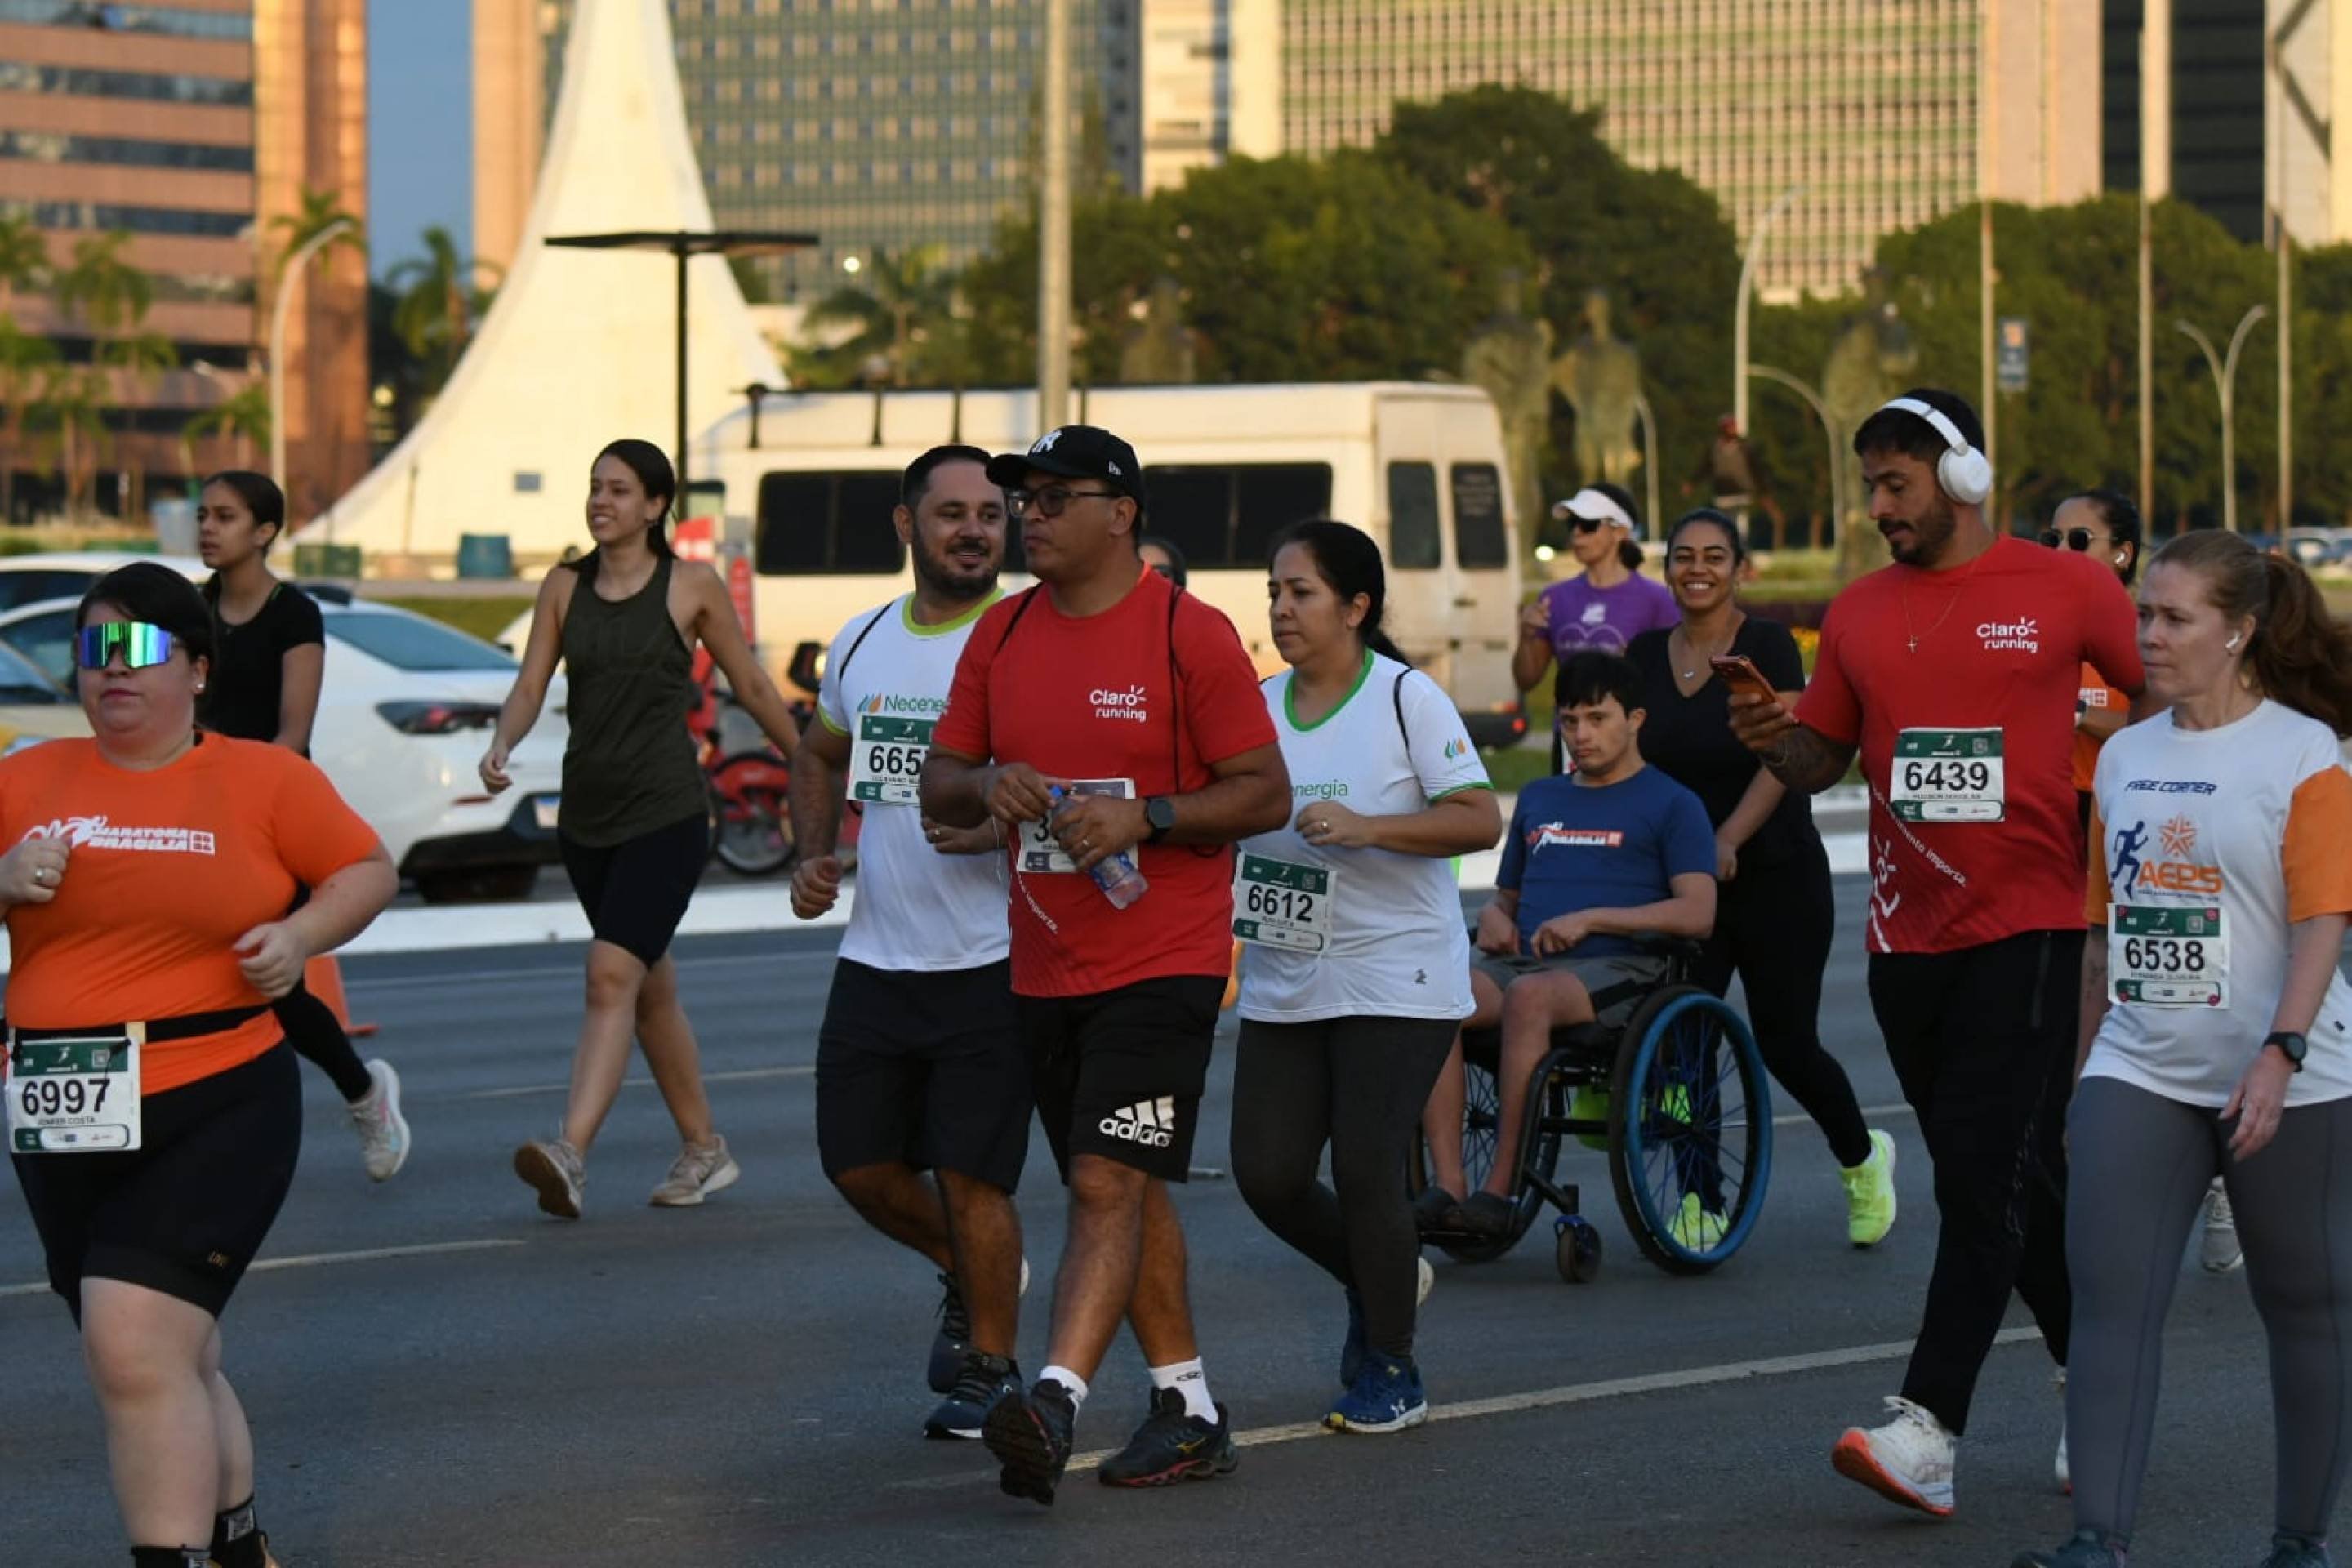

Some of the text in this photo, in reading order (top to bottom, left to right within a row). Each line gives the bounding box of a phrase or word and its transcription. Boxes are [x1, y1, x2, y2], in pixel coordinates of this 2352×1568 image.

[1976, 619, 2032, 638] Claro
[1984, 636, 2038, 653] running
[1089, 687, 1140, 706] Claro
[1095, 706, 1147, 723] running
[869, 745, 929, 776] 665
[1292, 779, 1348, 800] nergia
[1905, 761, 1989, 791] 6439
[2124, 779, 2161, 792] FREE
[2137, 859, 2224, 893] AEPS
[1248, 884, 1313, 923] 6612
[2125, 938, 2205, 972] 6538
[22, 1077, 110, 1116] 6997
[1098, 1117, 1172, 1147] adidas
